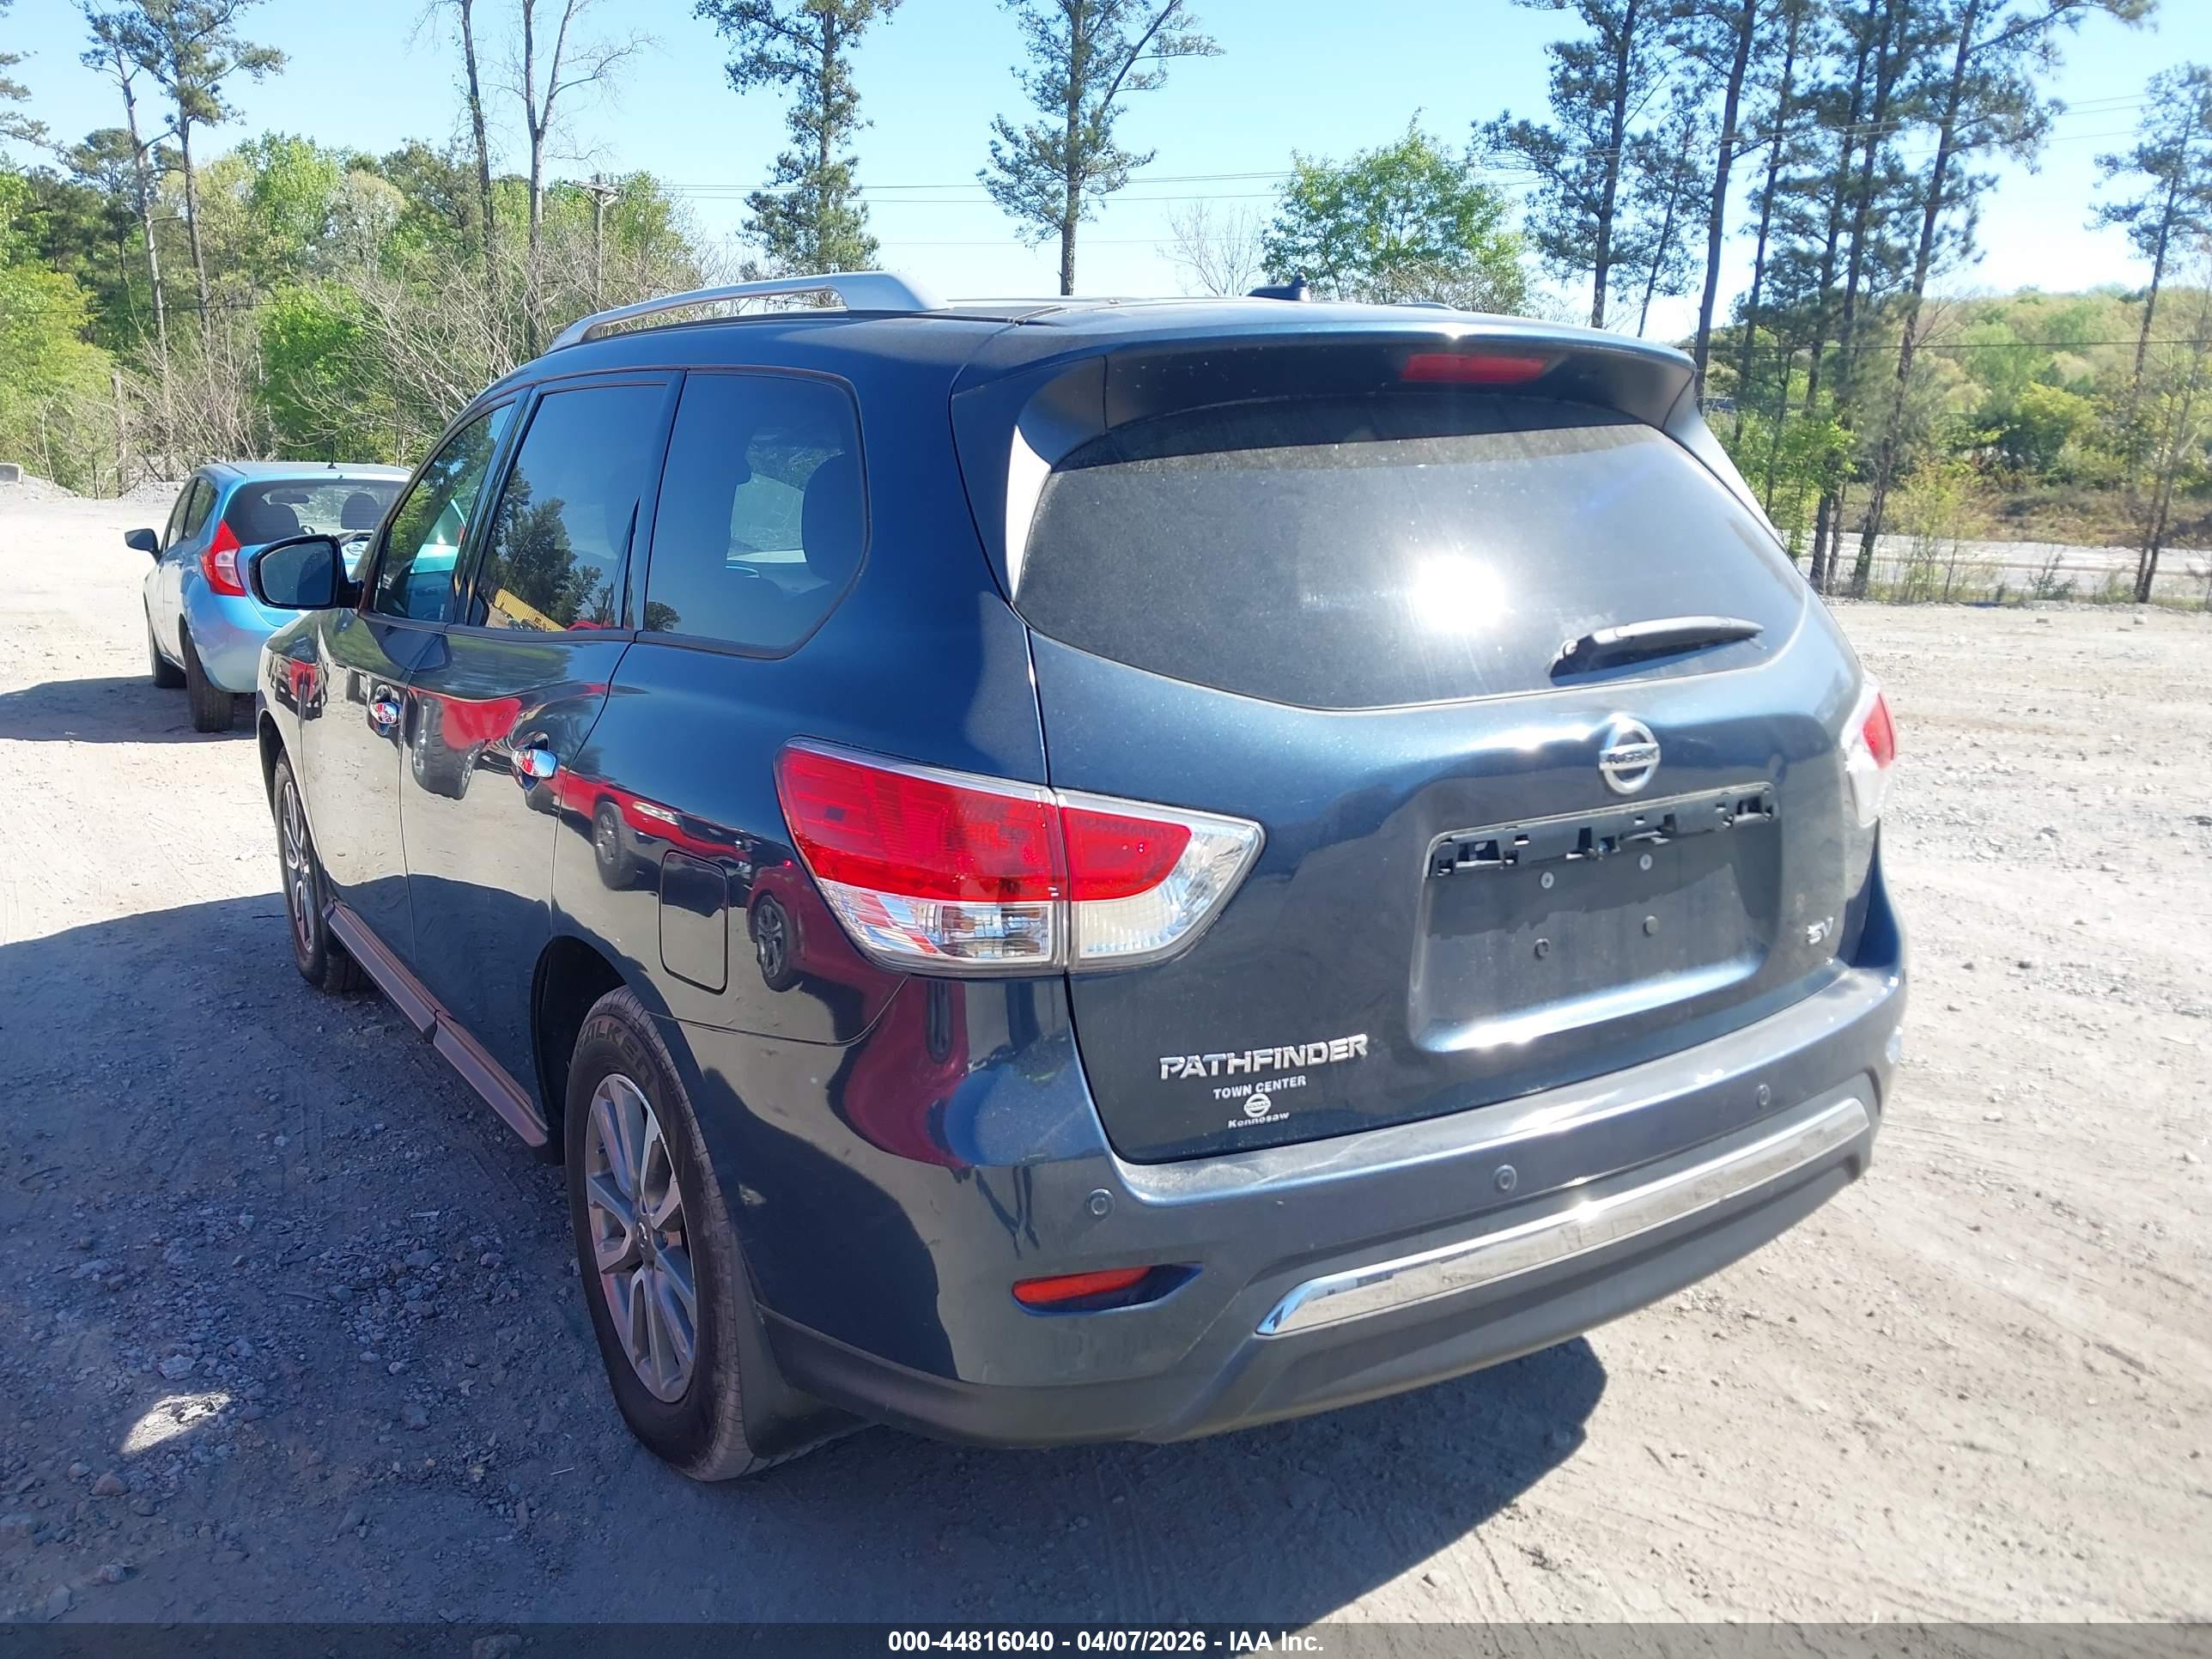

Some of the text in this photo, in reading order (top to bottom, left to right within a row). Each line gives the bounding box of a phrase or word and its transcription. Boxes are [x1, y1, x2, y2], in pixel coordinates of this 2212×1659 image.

[1807, 916, 1833, 945] SV
[1159, 1034, 1369, 1079] PATHFINDER
[1212, 1075, 1307, 1100] TOWN CENTER
[1228, 1111, 1291, 1129] Kennesaw
